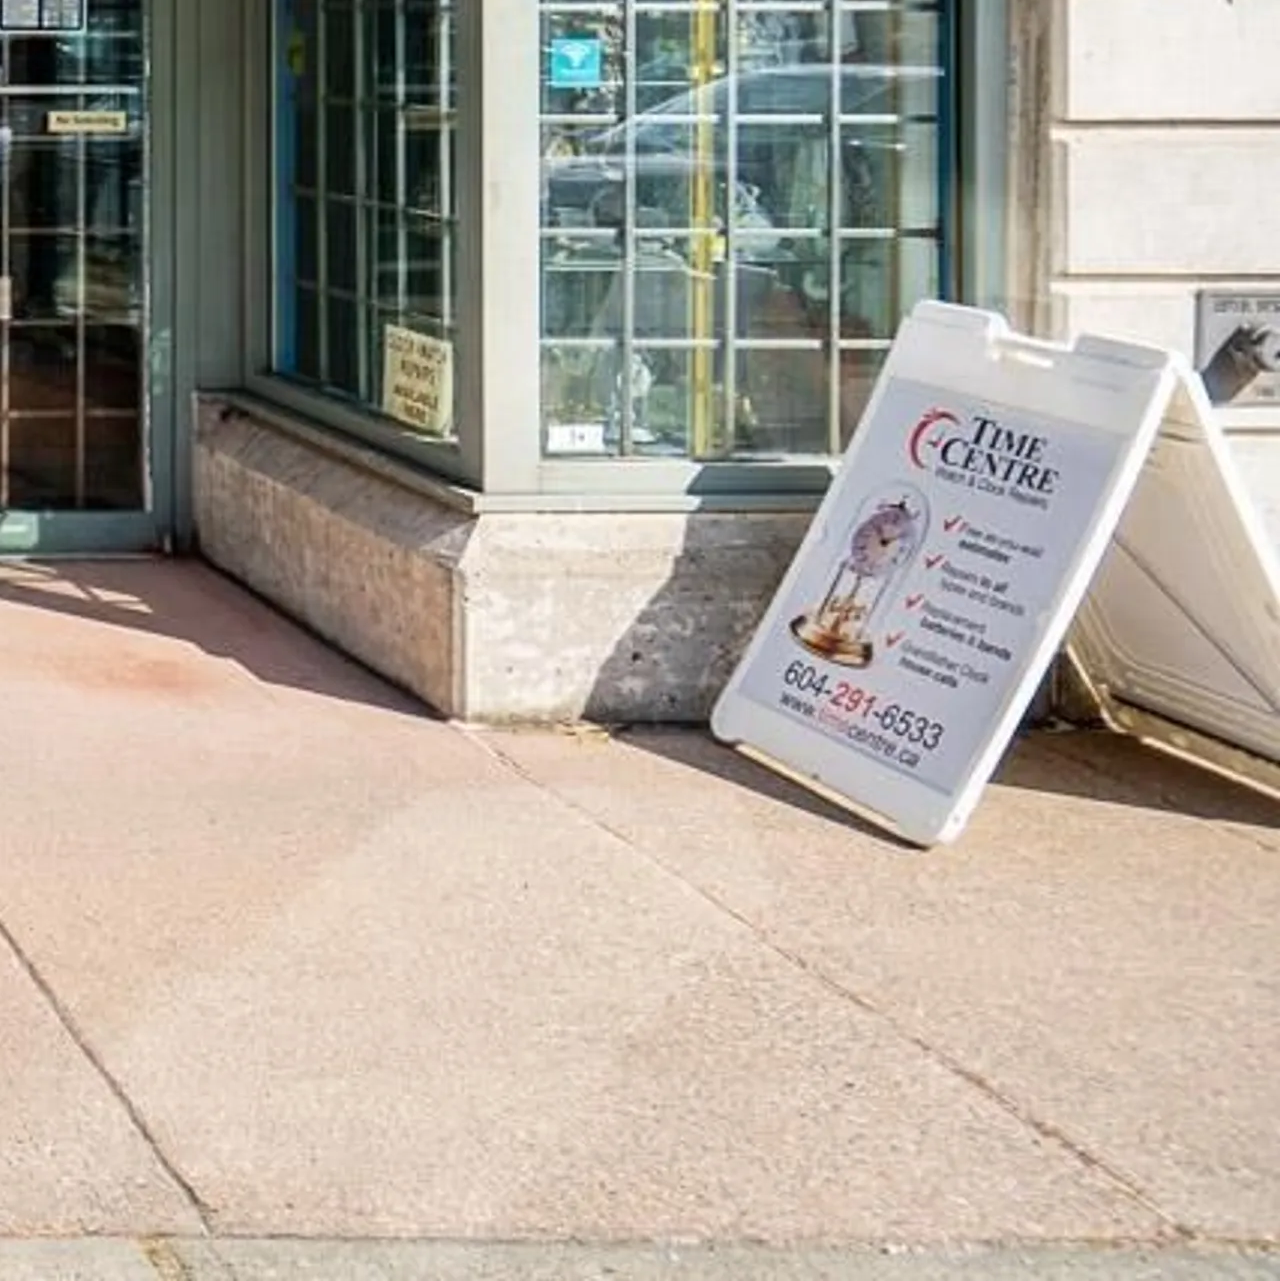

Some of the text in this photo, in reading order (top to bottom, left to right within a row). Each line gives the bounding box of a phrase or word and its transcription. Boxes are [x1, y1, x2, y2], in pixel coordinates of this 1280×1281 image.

[941, 437, 1060, 494] CENTRE
[973, 416, 1047, 464] TIME
[783, 660, 946, 751] 604-291-6533
